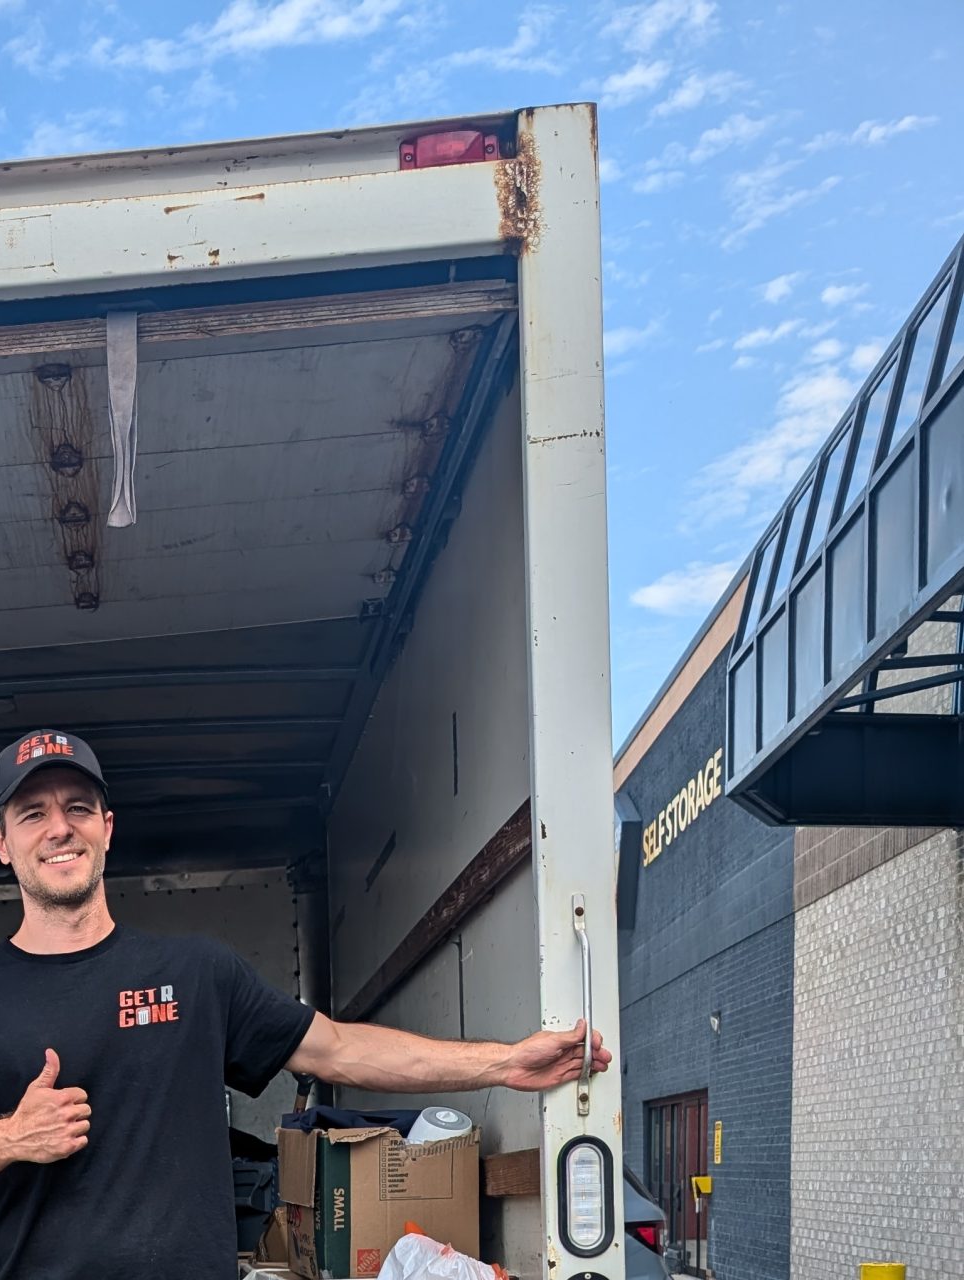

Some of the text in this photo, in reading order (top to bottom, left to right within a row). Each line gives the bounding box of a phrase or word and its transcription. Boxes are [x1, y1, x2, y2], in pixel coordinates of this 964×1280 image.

[18, 733, 68, 753] GET R
[643, 747, 723, 867] SELF STORAGE
[119, 984, 173, 1008] GET R
[333, 1188, 345, 1231] SMALL
